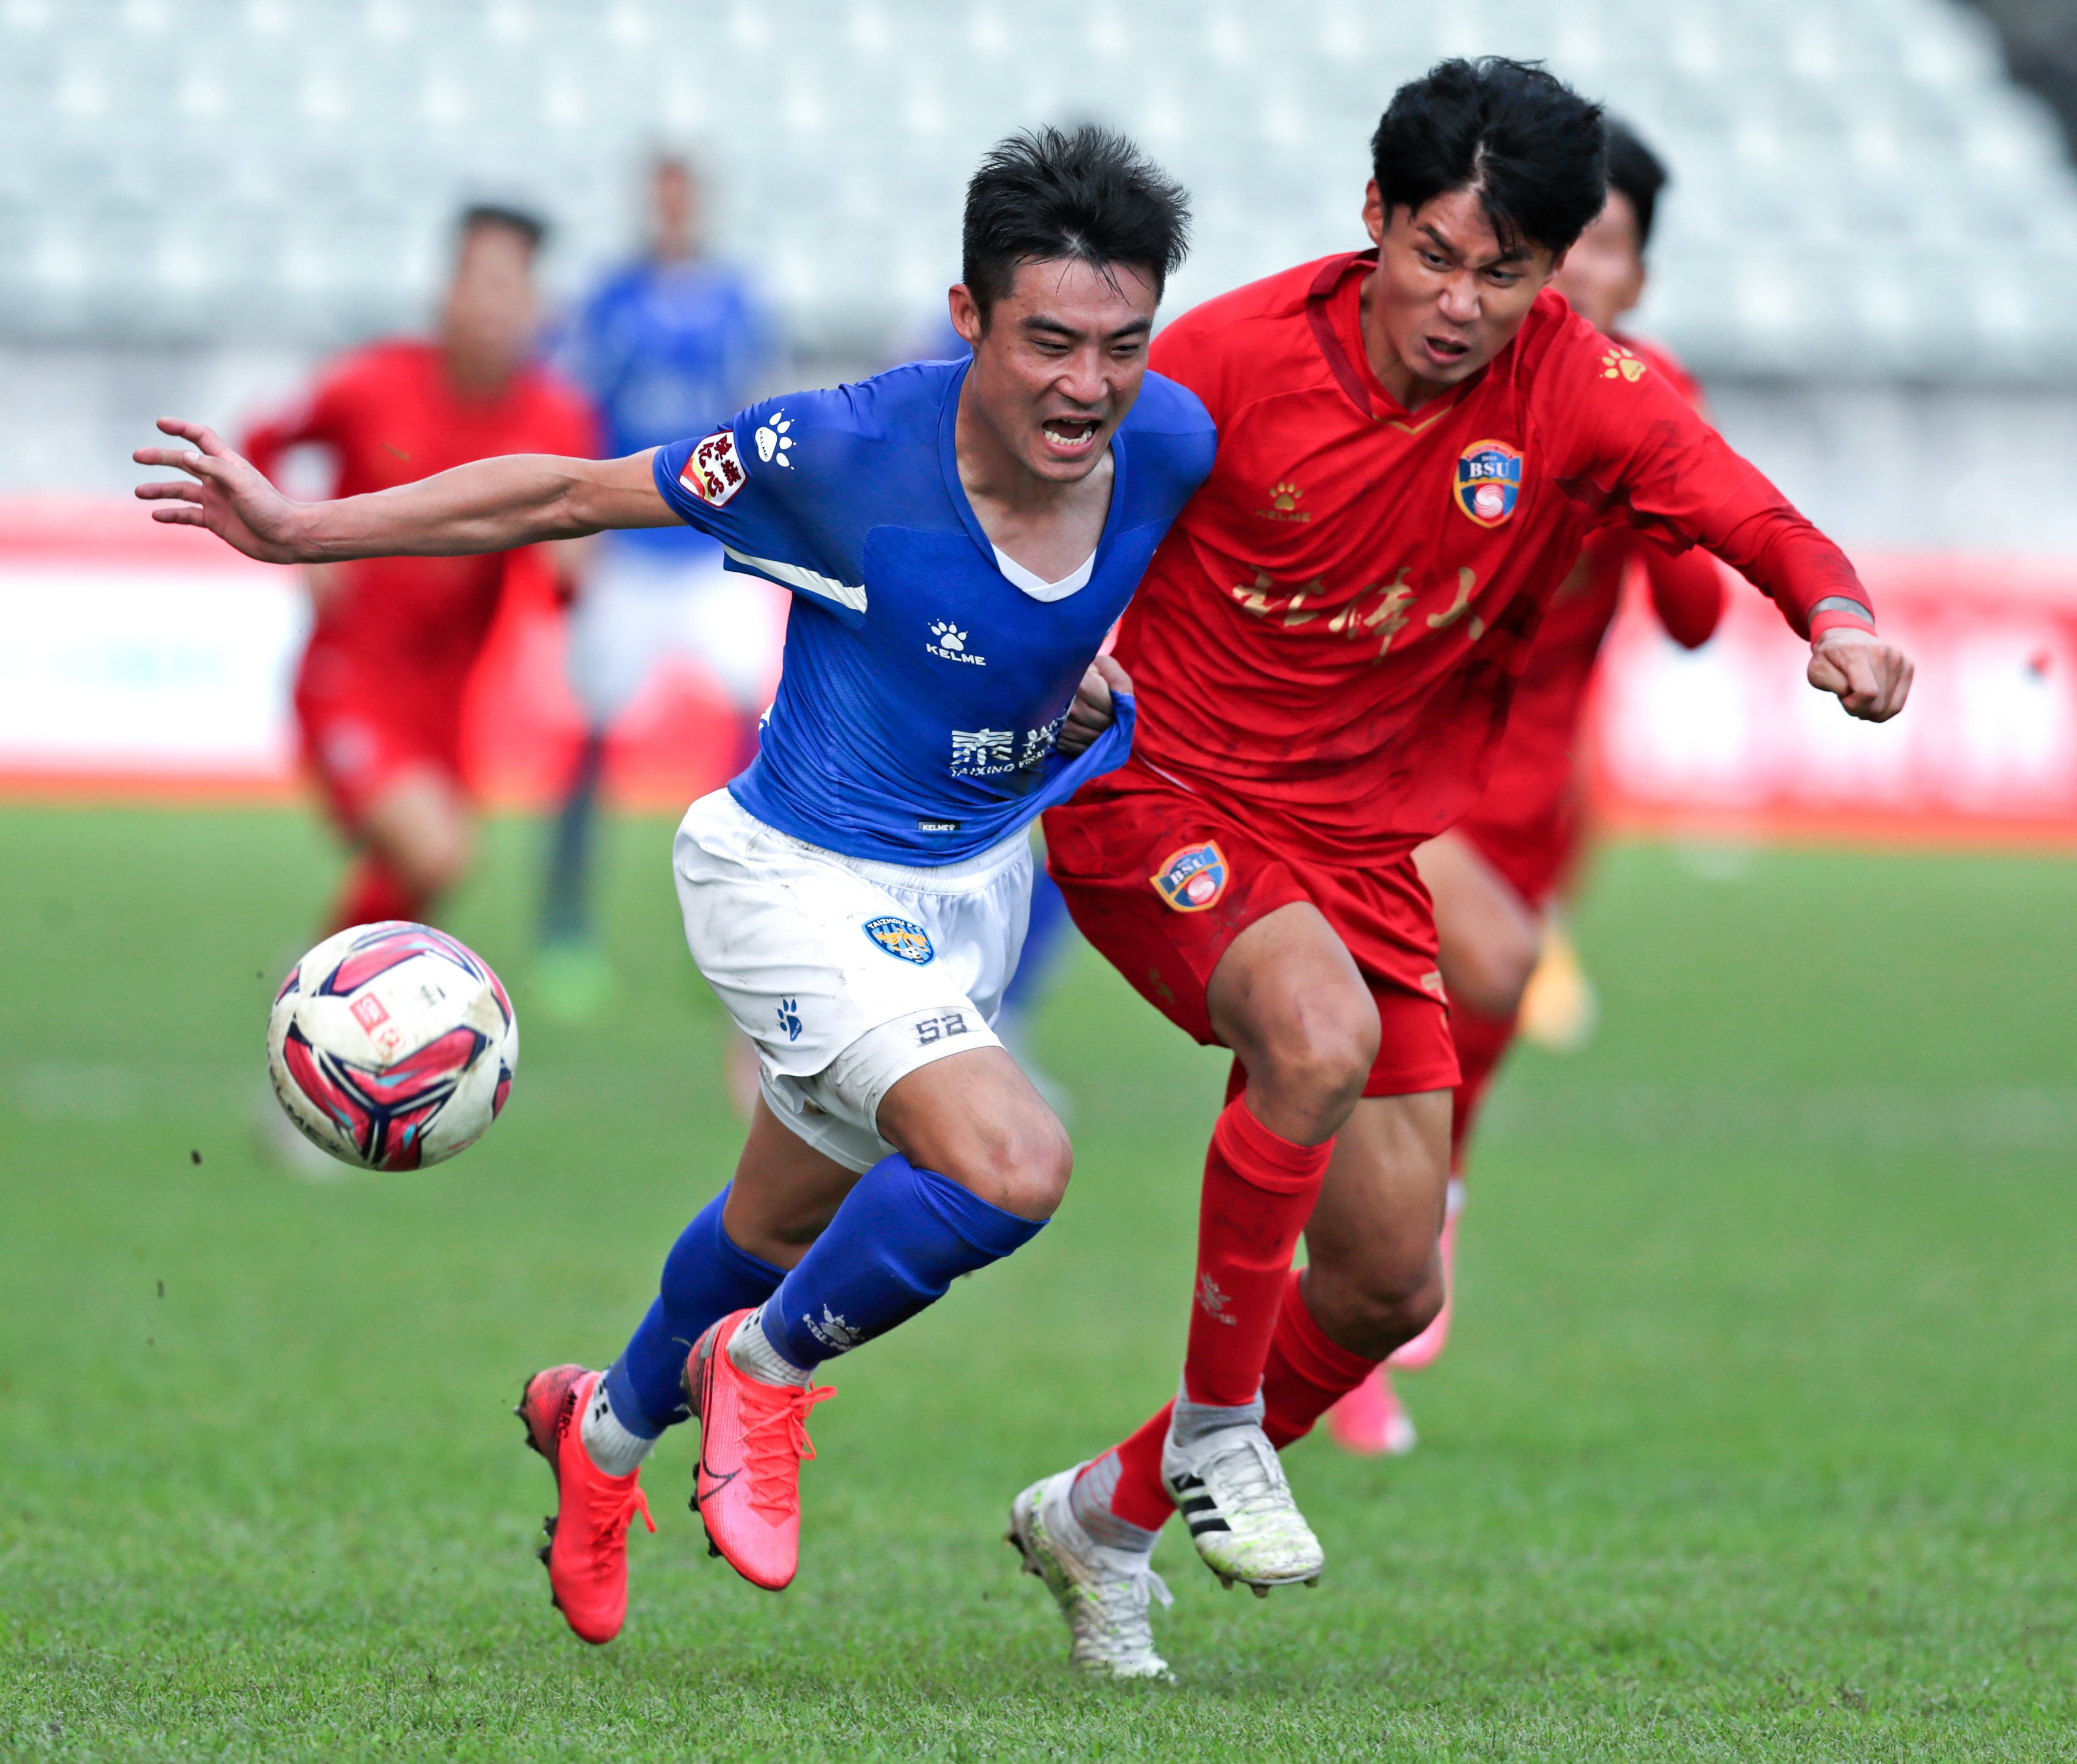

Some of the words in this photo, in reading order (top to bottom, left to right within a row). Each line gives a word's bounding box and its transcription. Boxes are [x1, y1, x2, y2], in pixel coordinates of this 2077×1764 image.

[759, 430, 768, 458] KELME
[1469, 462, 1510, 478] BSU
[926, 643, 986, 666] KELME
[949, 763, 1015, 777] TAIXING
[1170, 855, 1206, 885] BSU
[867, 918, 905, 930] TAIZHOU
[916, 1013, 967, 1044] 52
